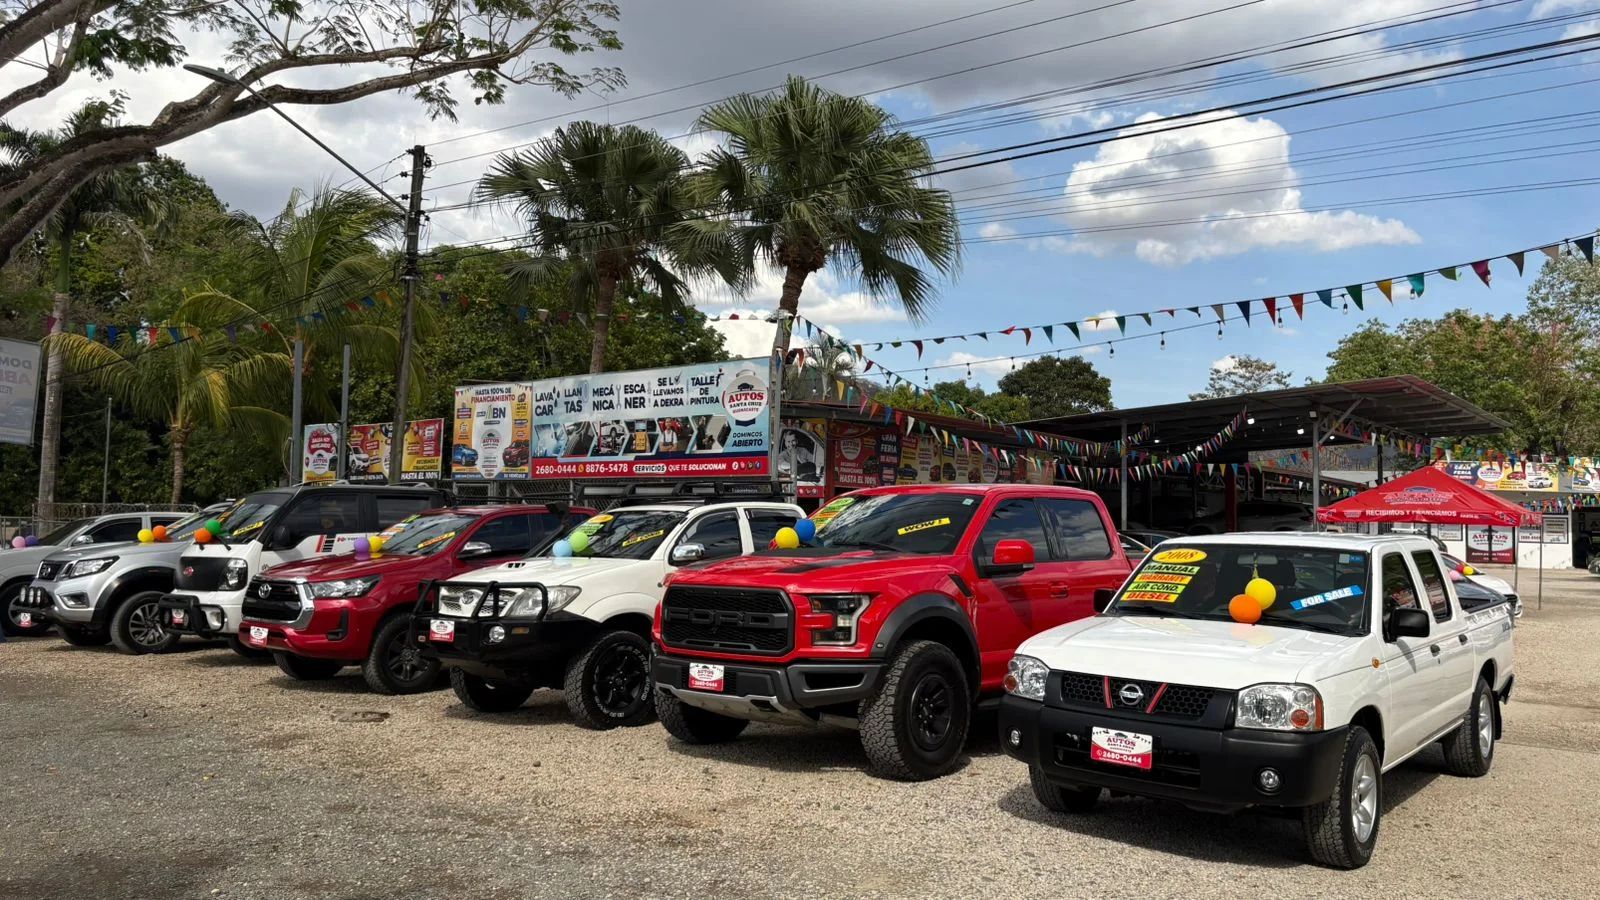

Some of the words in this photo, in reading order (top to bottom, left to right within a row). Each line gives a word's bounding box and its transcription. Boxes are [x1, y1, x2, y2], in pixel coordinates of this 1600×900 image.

[657, 377, 667, 387] SE
[475, 388, 490, 396] HASTA
[564, 388, 583, 398] LLAN
[592, 384, 615, 397] MECÁ
[624, 383, 646, 394] ESCA
[653, 387, 684, 396] LLEVAMOS
[471, 394, 515, 404] FINANCIAMIENTO
[535, 393, 554, 402] LAVA
[653, 399, 659, 407] A
[660, 398, 684, 407] DEKRA
[690, 396, 720, 405] PINTURA
[728, 392, 764, 403] AUTOS
[564, 400, 583, 413] TAS
[592, 399, 615, 411] NICA
[624, 397, 646, 409] NER
[492, 406, 506, 419] BN
[535, 404, 554, 416] CAR
[732, 439, 763, 447] ABIERTO
[881, 443, 898, 453] FERIA
[535, 464, 577, 474] 2680-0444
[585, 463, 628, 473] 8876-5478
[634, 464, 665, 472] SERVICIOS
[688, 463, 727, 471] SOLUCIONAN
[401, 472, 418, 480] HASTA
[840, 474, 857, 483] HASTA
[857, 475, 864, 484] EL
[904, 520, 935, 532] WOW
[1158, 551, 1198, 560] 2008
[1144, 565, 1196, 573] MANUAL
[1132, 583, 1150, 591] AIR
[1150, 584, 1178, 592] COND.
[1126, 592, 1171, 600] DIESEL
[1300, 594, 1325, 608] FOR
[1323, 587, 1354, 602] SALE
[665, 607, 789, 629] FORD
[1107, 737, 1136, 747] AUTOS
[1102, 751, 1142, 764] 2680-0444
